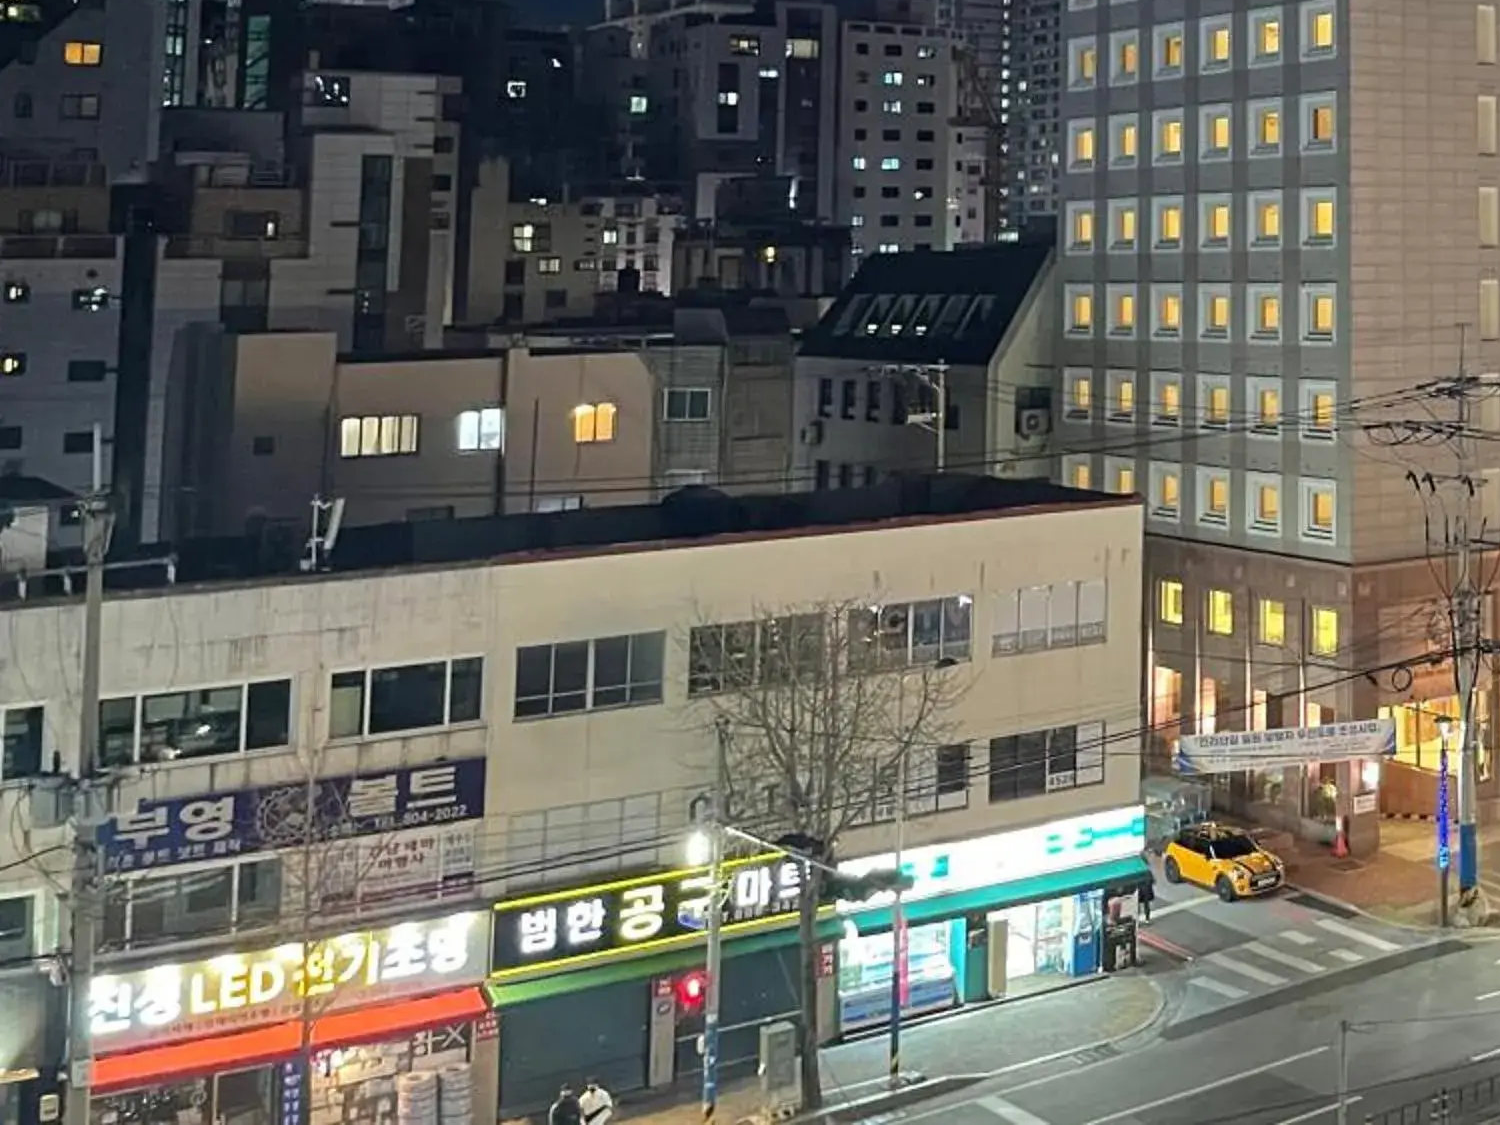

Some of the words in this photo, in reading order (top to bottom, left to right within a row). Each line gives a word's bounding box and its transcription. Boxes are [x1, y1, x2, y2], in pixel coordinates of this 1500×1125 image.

[112, 796, 236, 851] 부영
[348, 765, 459, 818] 볼트
[191, 961, 285, 1015] LED
